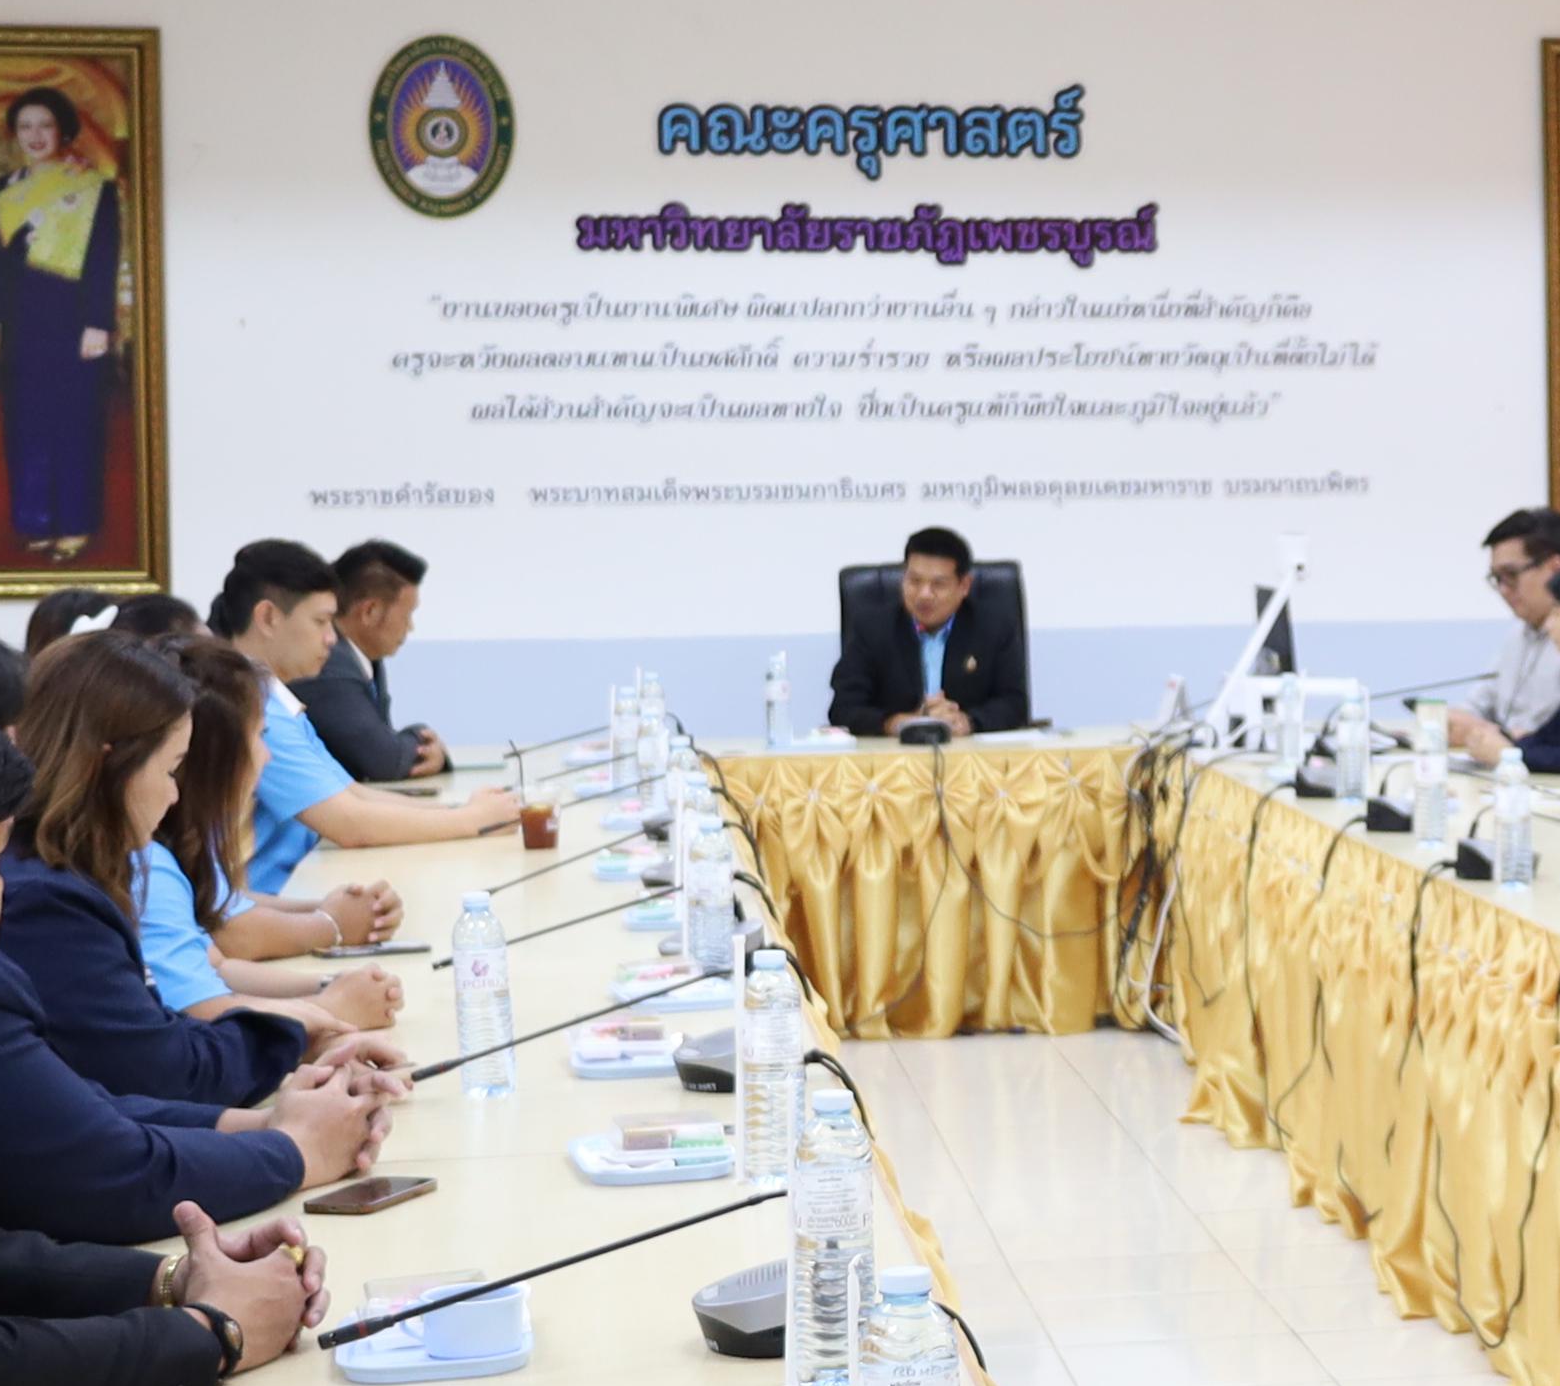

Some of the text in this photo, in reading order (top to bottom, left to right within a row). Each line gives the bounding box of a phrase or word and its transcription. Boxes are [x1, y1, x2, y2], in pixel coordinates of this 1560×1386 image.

[657, 84, 1086, 180] คณะครุศาสตร์
[575, 201, 1160, 268] มหาวิทยาลัยราชภัฏเพชรบูรณ์
